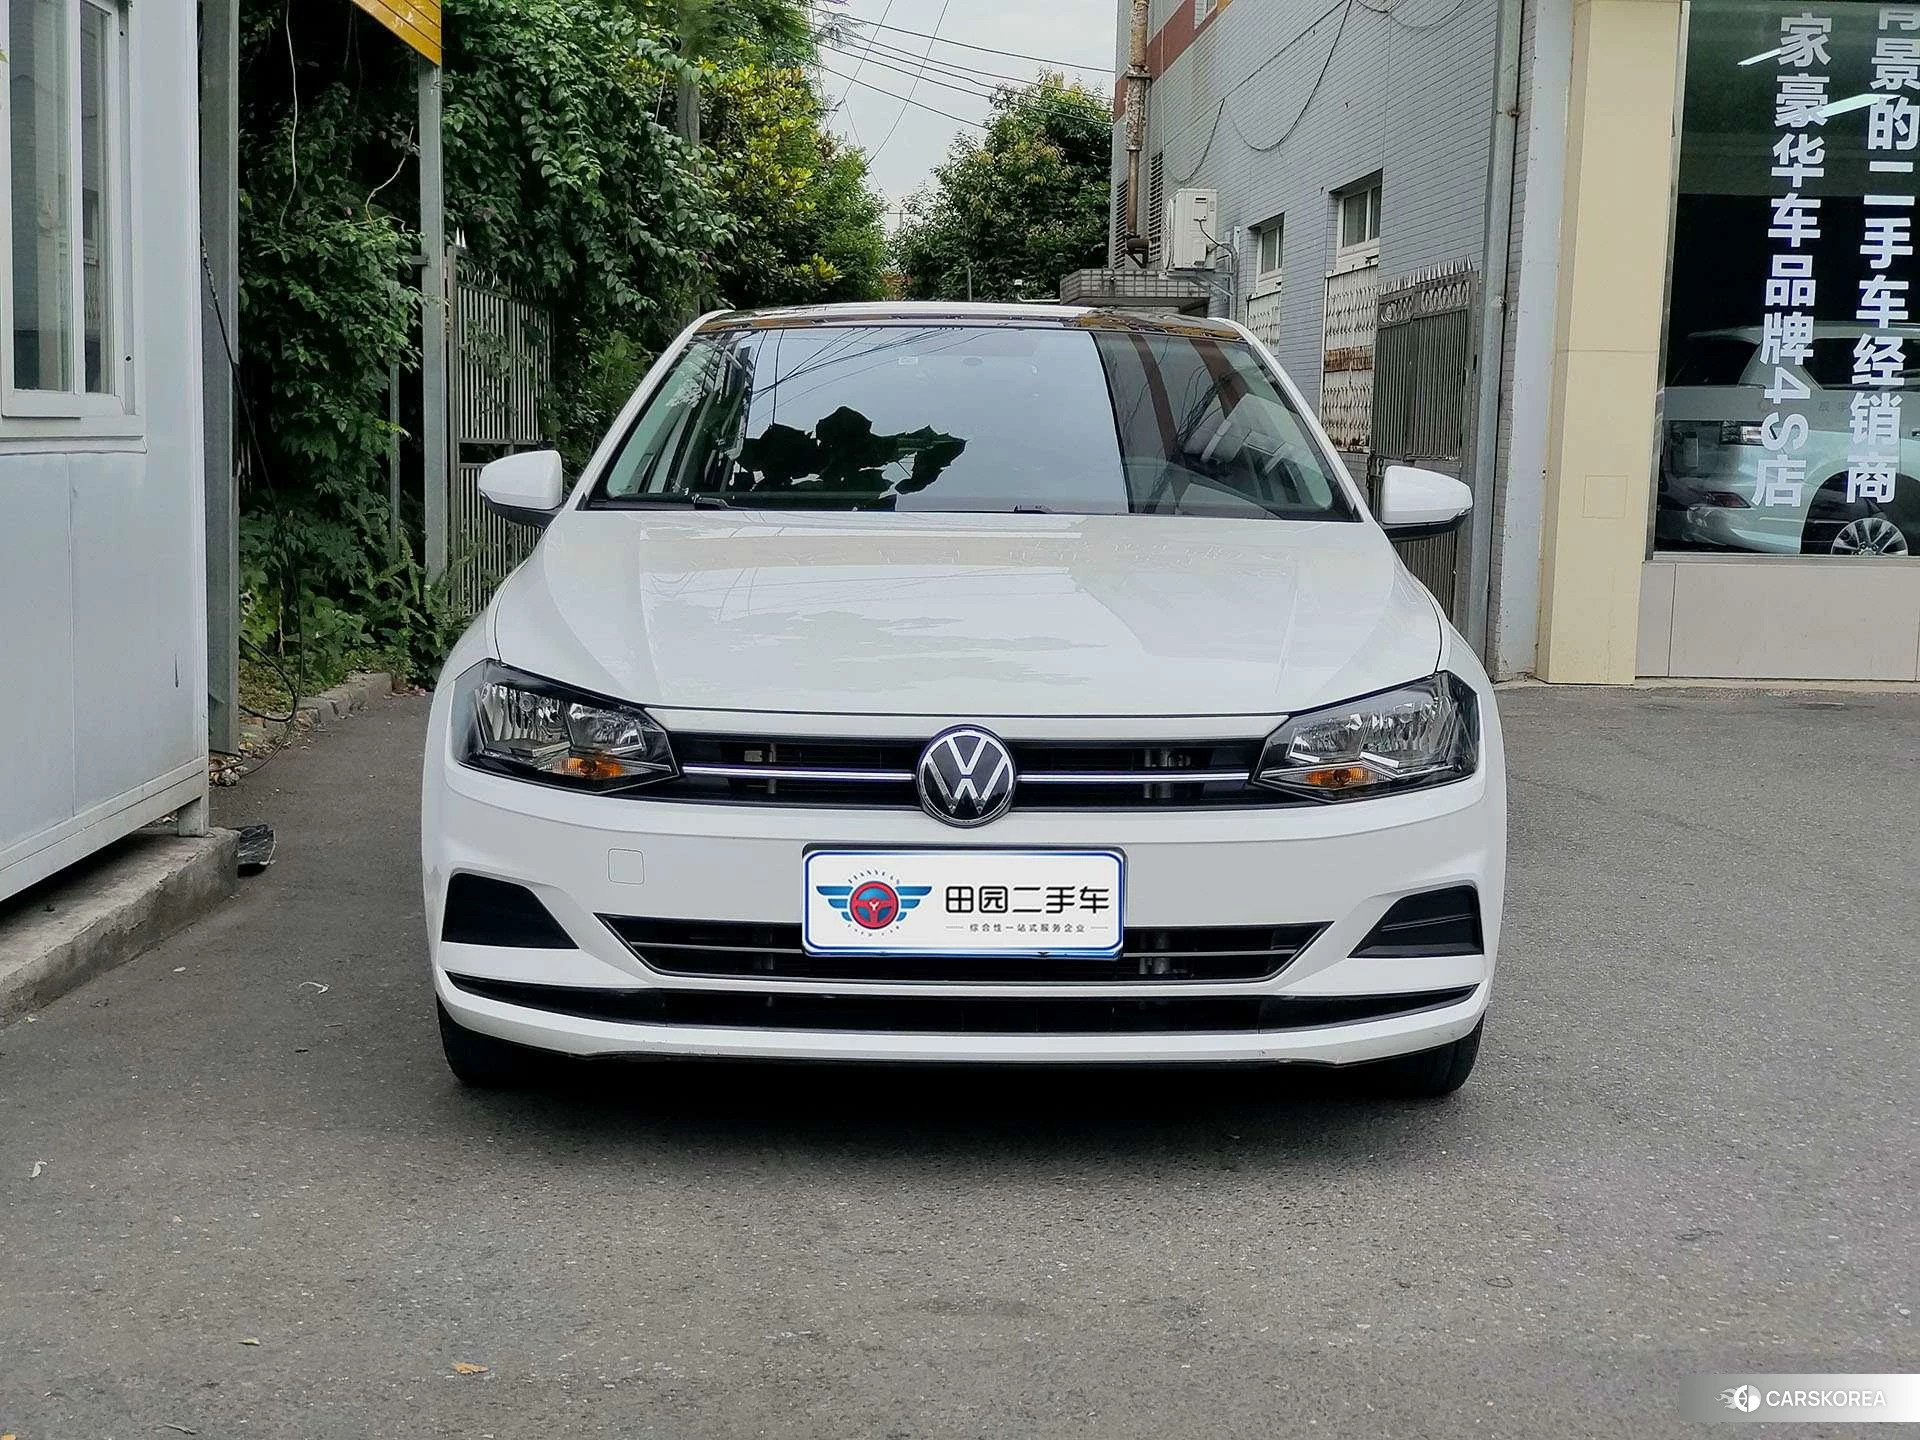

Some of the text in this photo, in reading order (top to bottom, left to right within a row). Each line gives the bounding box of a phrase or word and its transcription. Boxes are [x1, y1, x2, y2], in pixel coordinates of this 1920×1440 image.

[1751, 13, 1833, 507] 家豪华车品牌4S店
[924, 734, 1009, 817] VW
[945, 886, 1110, 914] 田园二手车
